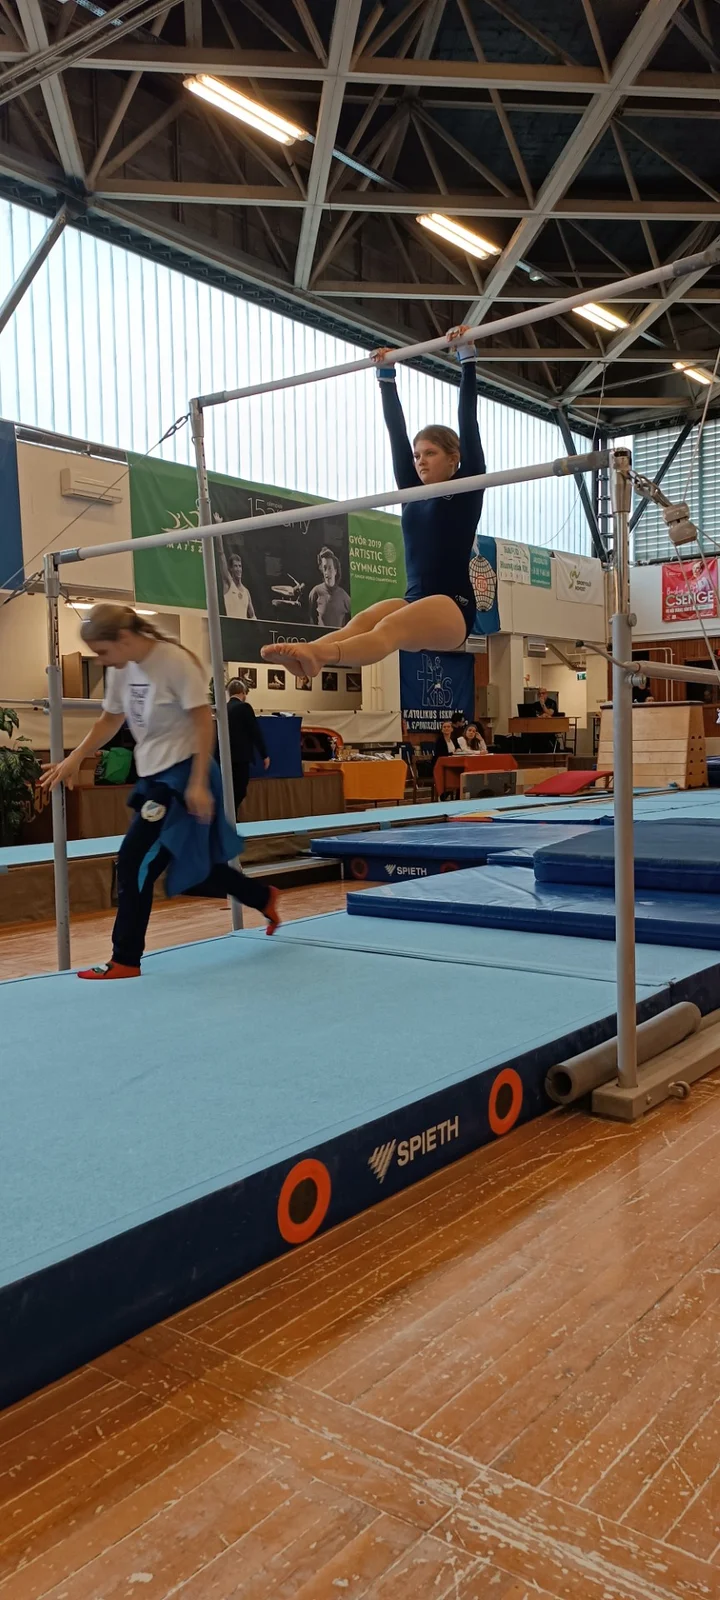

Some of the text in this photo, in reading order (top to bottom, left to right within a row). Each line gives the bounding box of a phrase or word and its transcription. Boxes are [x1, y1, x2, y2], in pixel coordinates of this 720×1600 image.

[368, 539, 382, 548] 2019
[349, 547, 383, 561] ARTISTIC
[350, 561, 397, 576] GYMNASTICS
[666, 590, 714, 607] CSENGE
[403, 709, 437, 719] KATOLIKUS
[396, 866, 427, 876] SPIETH
[397, 1115, 459, 1167] SPIETH
